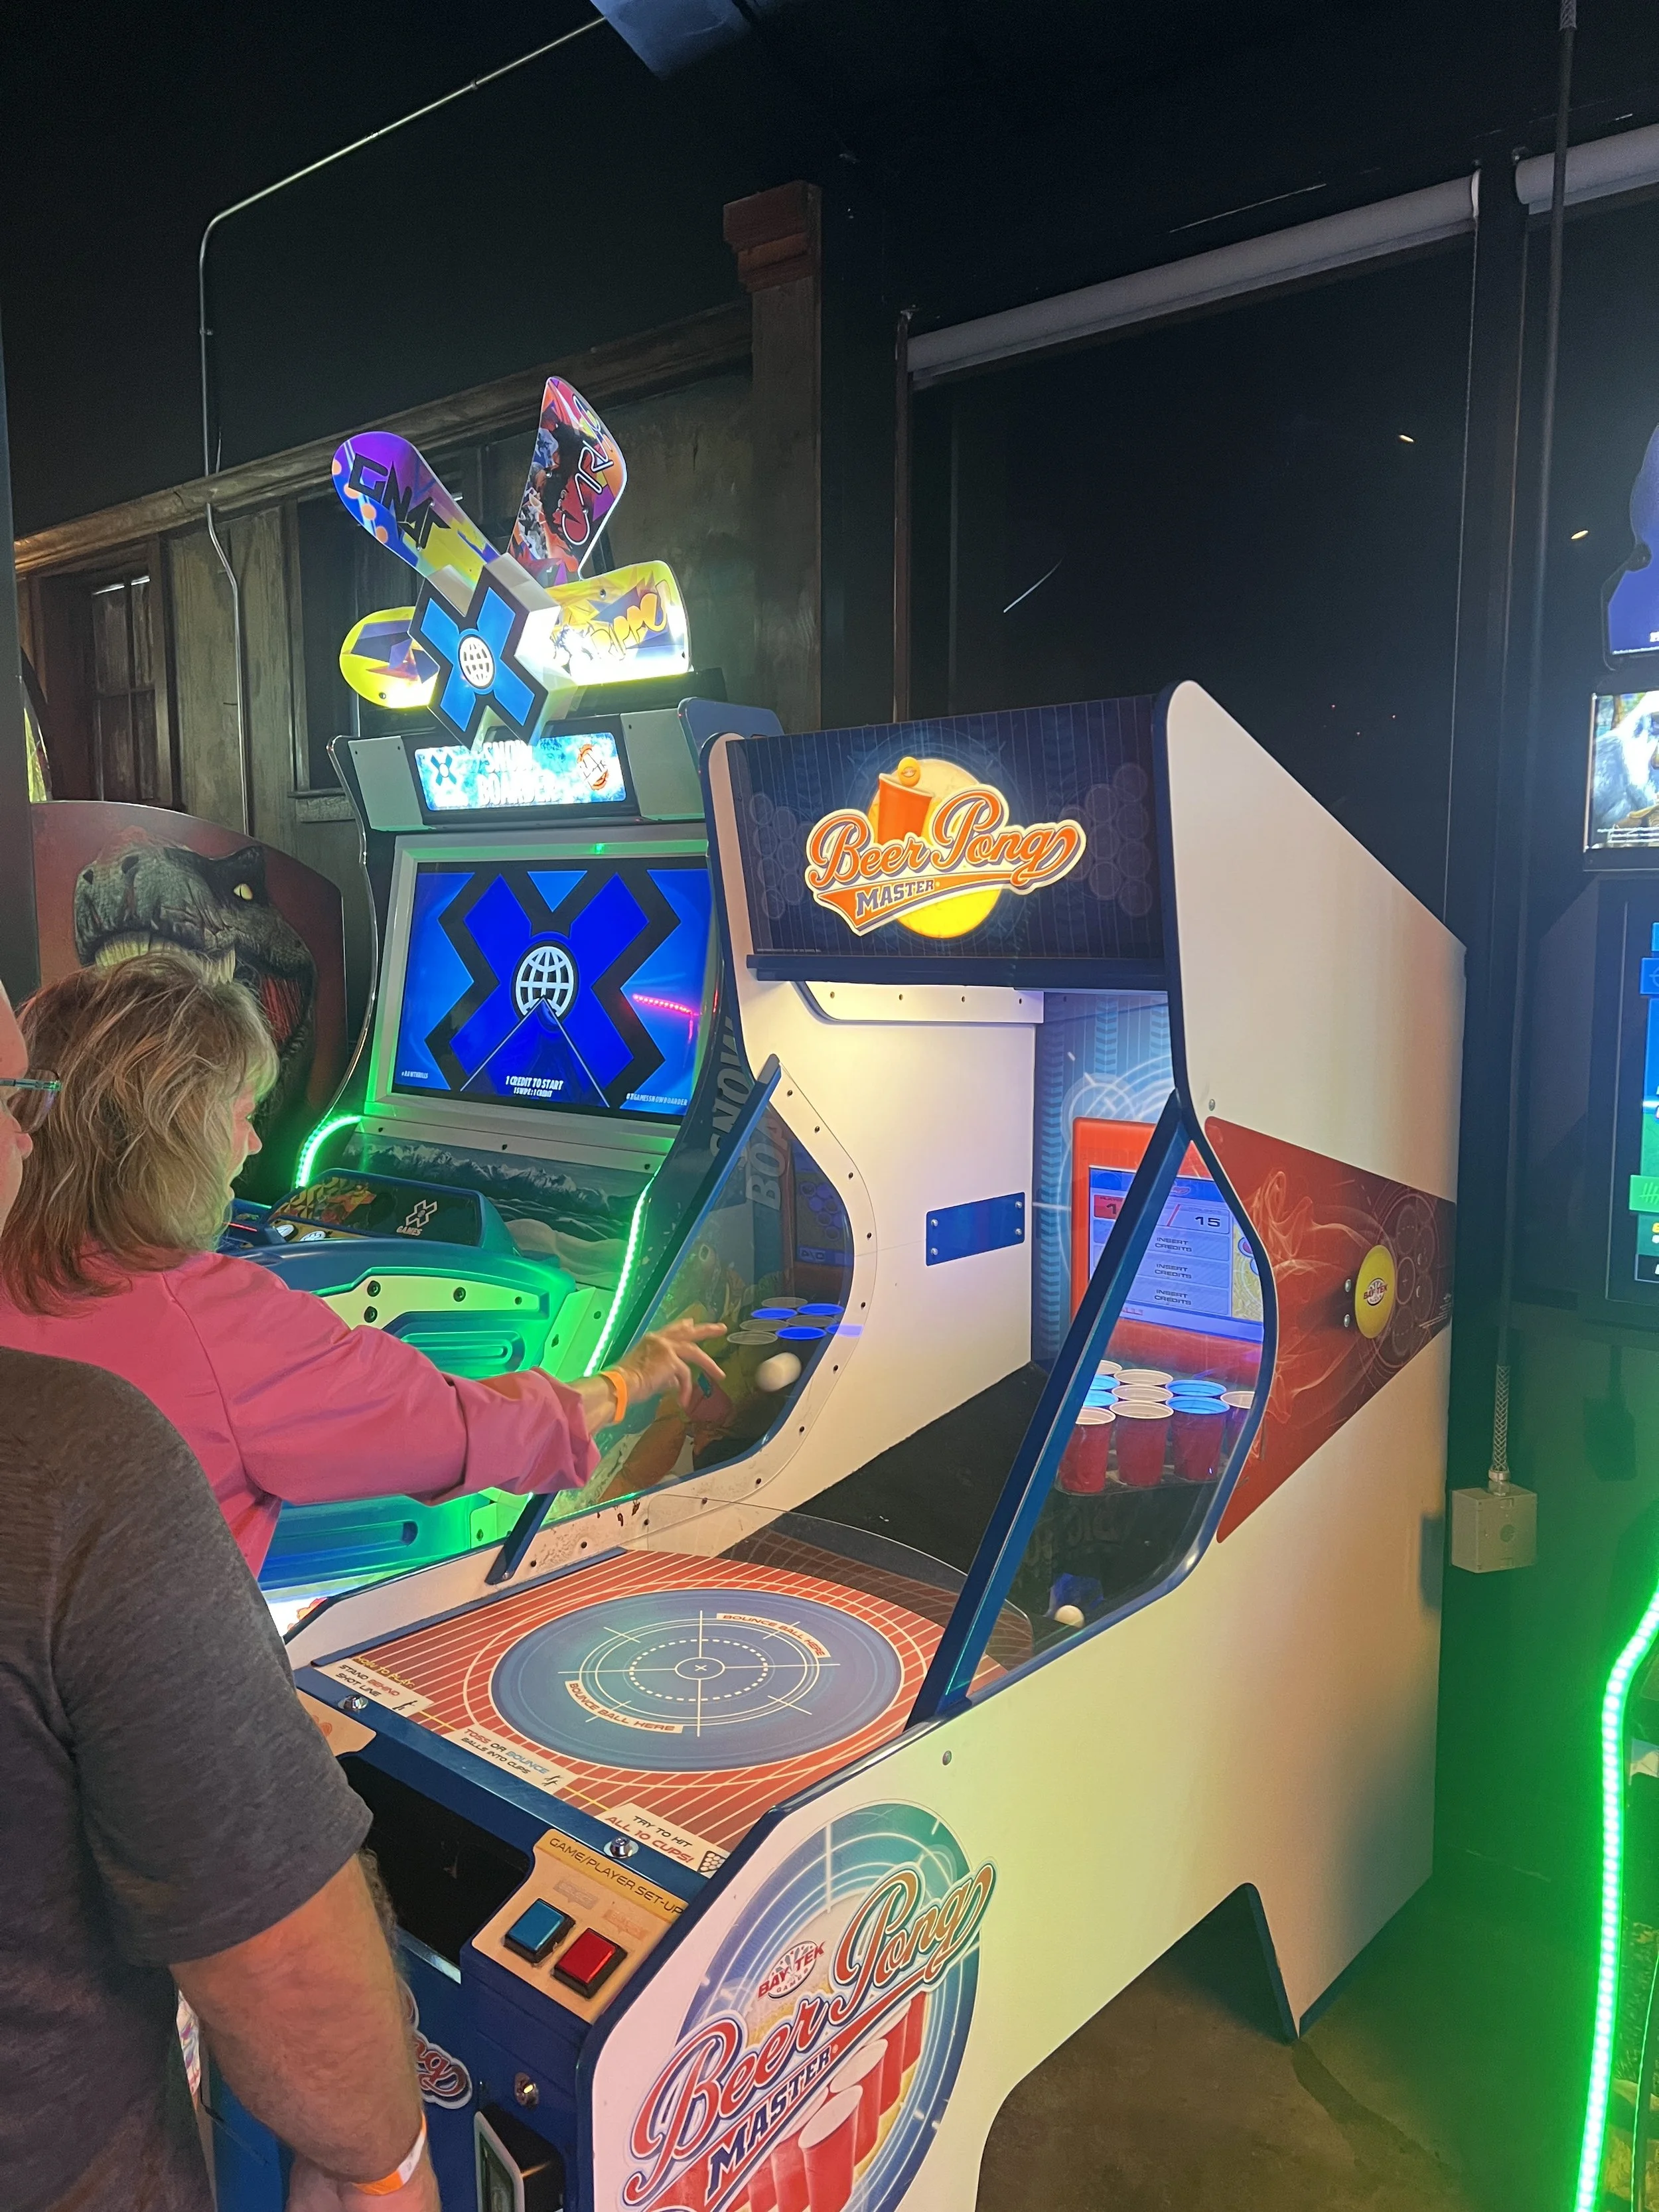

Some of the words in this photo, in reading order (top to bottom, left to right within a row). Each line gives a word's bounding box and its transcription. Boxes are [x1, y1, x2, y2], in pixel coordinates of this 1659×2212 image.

[348, 453, 451, 550] GNAR
[808, 814, 929, 889] Beer
[931, 788, 1080, 888] Pong
[856, 879, 935, 918] MASTER
[506, 1075, 510, 1085] 1
[510, 1076, 532, 1087] CREDIT
[532, 1078, 541, 1088] TO
[541, 1079, 564, 1090] START
[1106, 1203, 1117, 1215] 1
[1195, 1216, 1221, 1227] 15
[396, 1225, 423, 1236] GAMES
[1155, 1243, 1192, 1252] CREDITS
[1155, 1269, 1192, 1279] CREDITS
[1157, 1264, 1189, 1272] INSERT
[1154, 1295, 1192, 1305] CREDITS
[1156, 1289, 1188, 1298] INSERT
[723, 1614, 778, 1627] BOUNCE
[778, 1625, 804, 1640] BALL
[804, 1639, 826, 1657] HERE
[336, 1672, 362, 1686] SHOT
[359, 1684, 383, 1697] LINE
[339, 1664, 369, 1680] STAND
[367, 1678, 400, 1696] BEHIND
[376, 1666, 390, 1676] TO
[569, 1682, 600, 1711] BOUNCE
[597, 1708, 630, 1725] BALL
[634, 1721, 676, 1732] HERE
[461, 1737, 489, 1752] BALLS
[486, 1751, 508, 1762] INTO
[507, 1761, 532, 1775] CUPS
[464, 1729, 491, 1744] TOSS
[490, 1743, 508, 1753] OR
[506, 1751, 550, 1775] BOUNCE
[605, 1816, 633, 1832] ALL
[634, 1830, 651, 1840] 10
[652, 1839, 695, 1863] CUPS!
[632, 1815, 658, 1828] TRY
[656, 1827, 672, 1838] TO
[671, 1836, 693, 1848] HIT
[549, 1837, 636, 1891] GAME/PLAYER
[634, 1885, 684, 1915] SET-UP
[758, 1966, 789, 1999] BAY
[794, 1941, 826, 1972] TEK
[624, 1996, 830, 2205] Beer
[829, 1861, 995, 2024] Pong
[705, 2045, 831, 2202] MASTER
